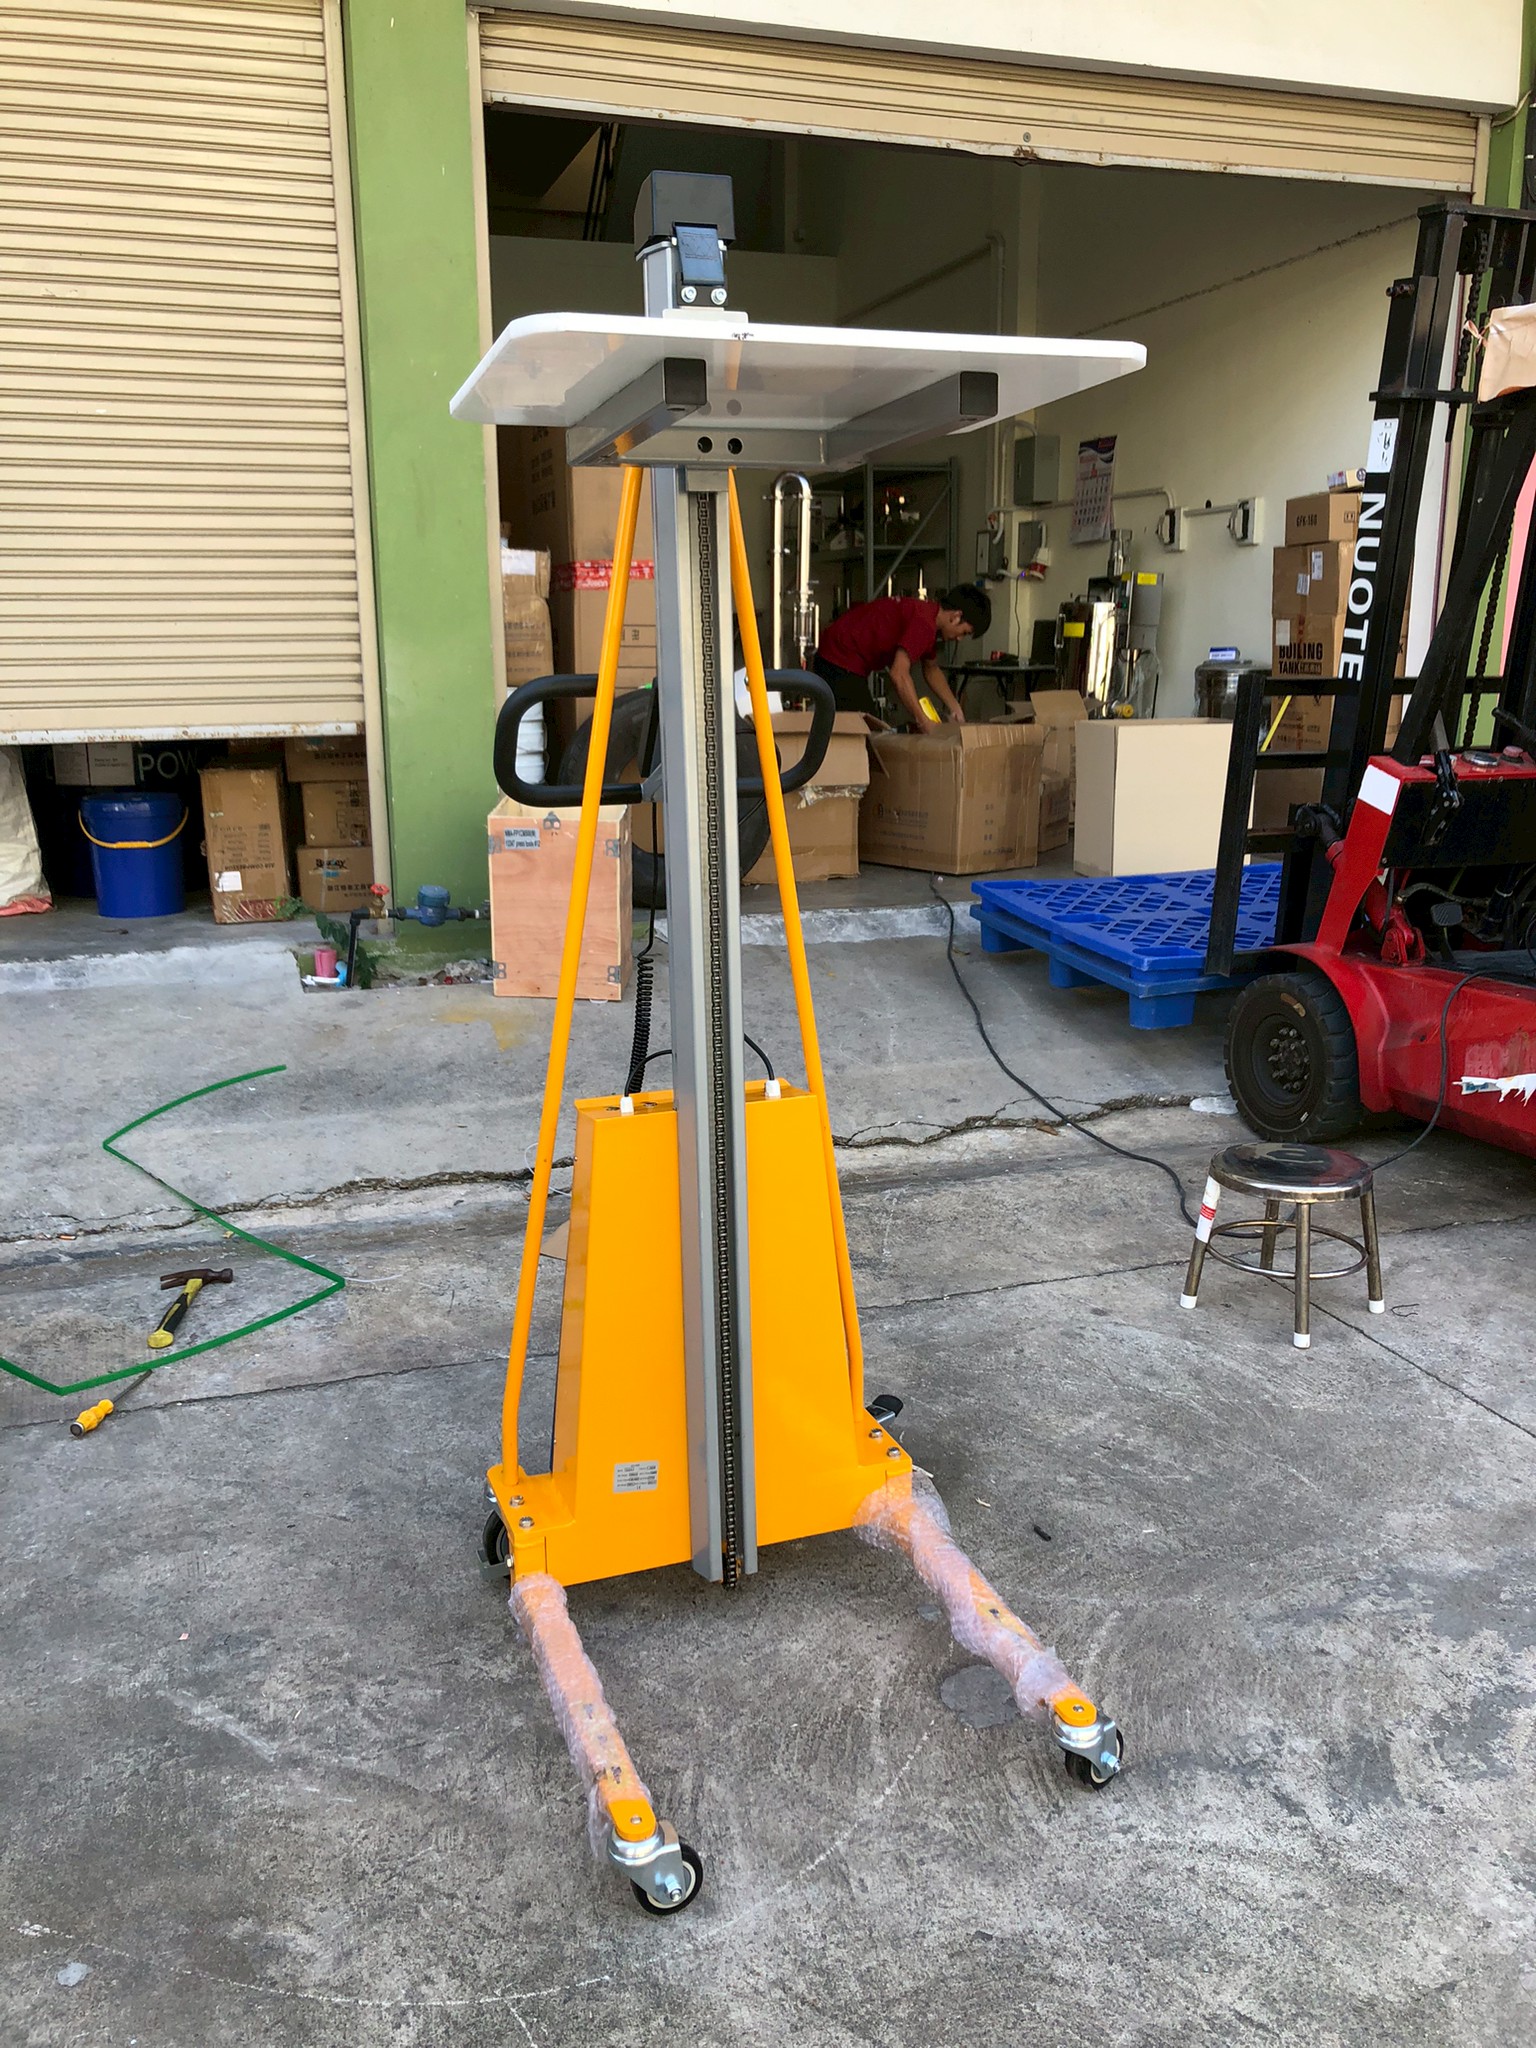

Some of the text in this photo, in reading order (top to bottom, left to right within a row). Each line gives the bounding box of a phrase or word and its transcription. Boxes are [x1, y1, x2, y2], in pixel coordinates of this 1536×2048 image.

[1338, 493, 1386, 681] NUOTE
[1279, 642, 1323, 660] BOILING
[1279, 661, 1300, 675] TANK
